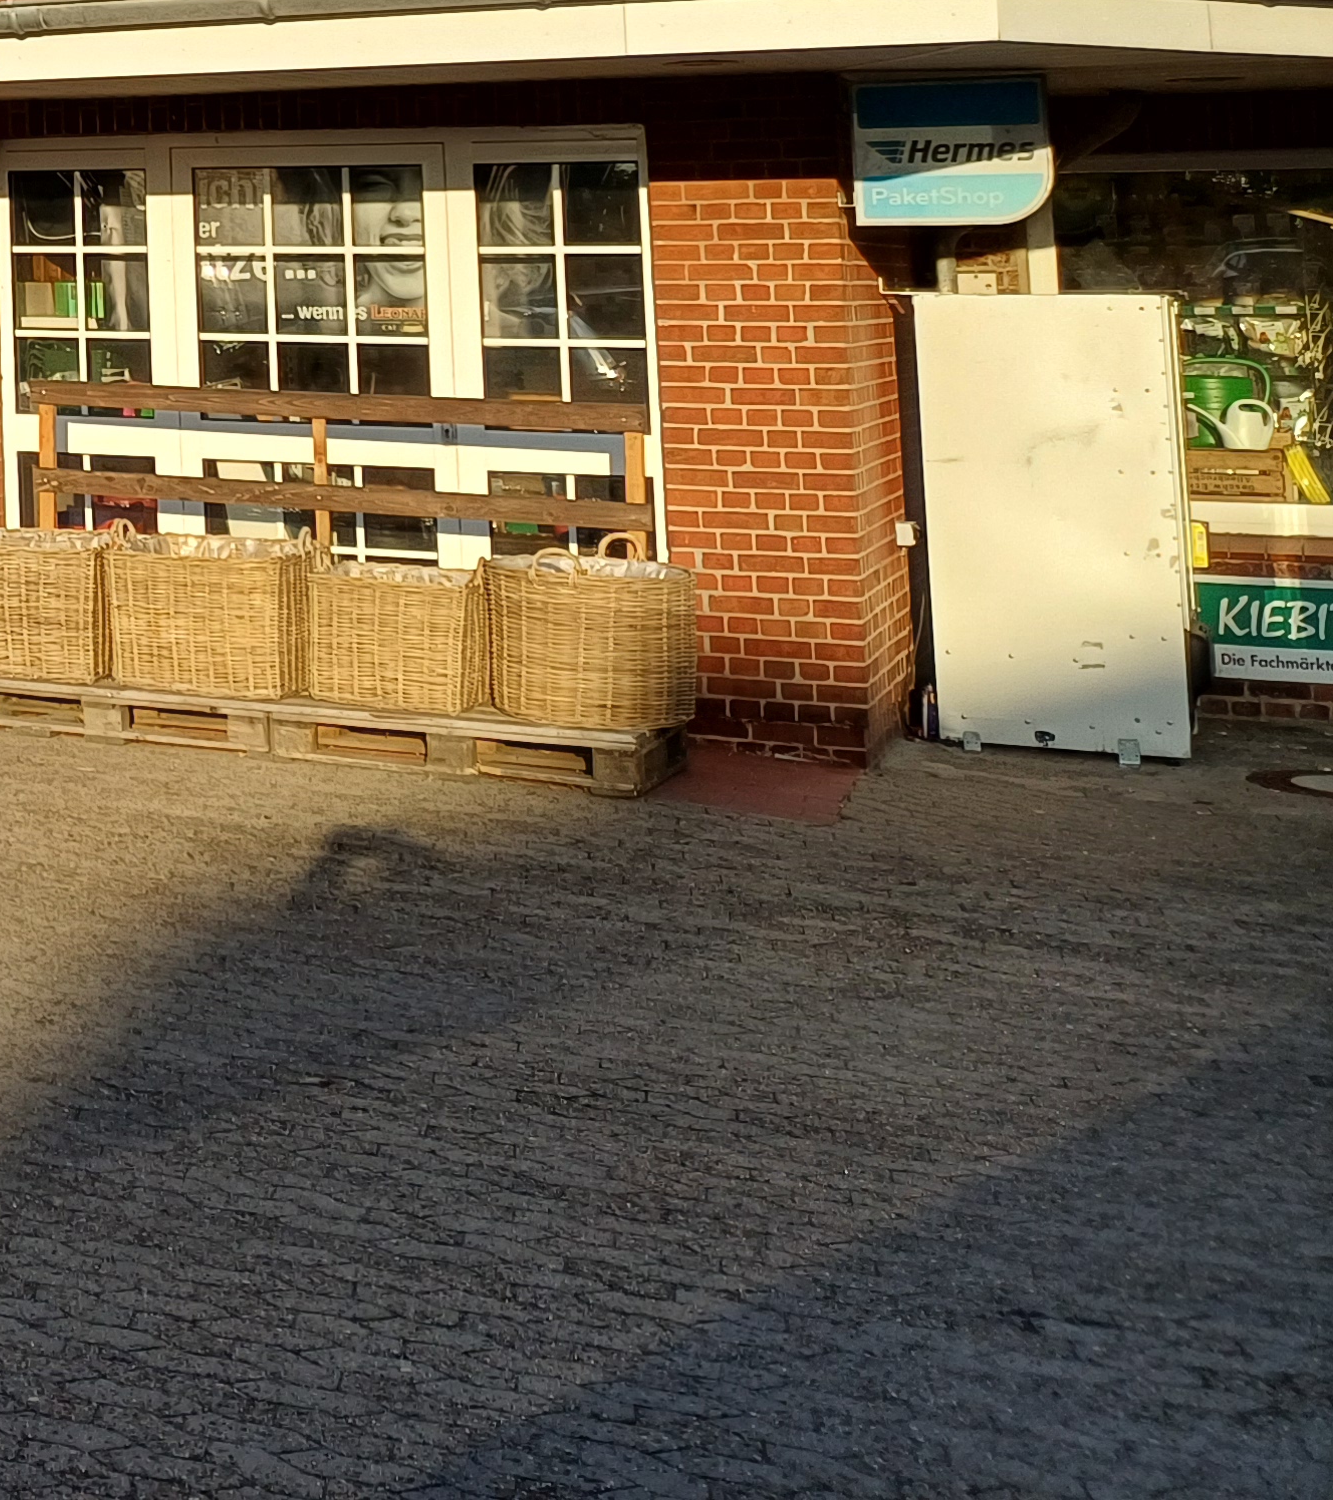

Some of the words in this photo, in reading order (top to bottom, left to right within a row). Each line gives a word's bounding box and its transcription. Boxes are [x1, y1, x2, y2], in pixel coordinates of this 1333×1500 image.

[907, 139, 1036, 165] Hermes
[871, 185, 1006, 209] PaketShop
[296, 304, 344, 321] wenn
[1218, 595, 1333, 640] KIEBI
[1221, 653, 1246, 667] Die
